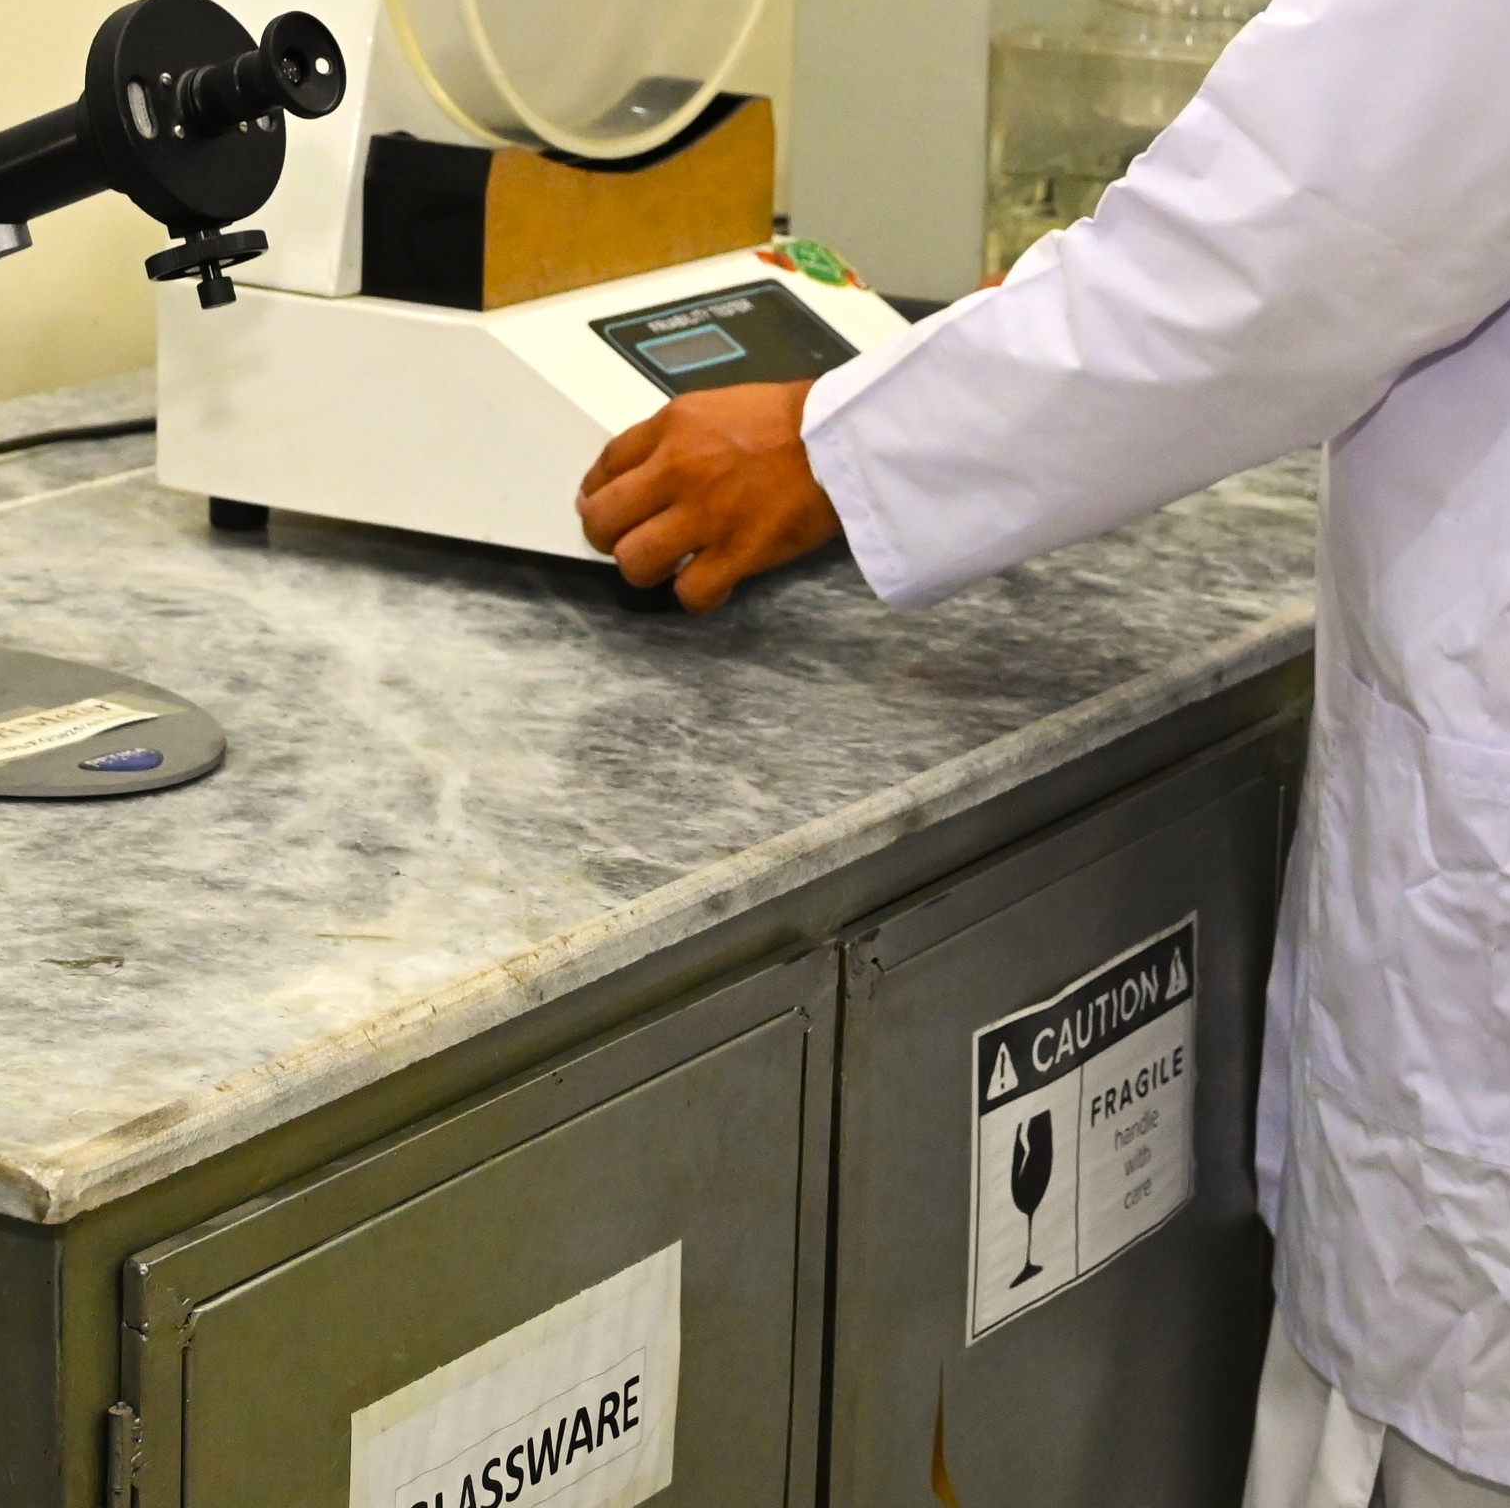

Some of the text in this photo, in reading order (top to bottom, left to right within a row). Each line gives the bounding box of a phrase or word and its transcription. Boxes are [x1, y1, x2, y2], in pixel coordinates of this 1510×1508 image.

[1031, 964, 1159, 1073] CAUTION
[1090, 1045, 1185, 1127] FRAGILE
[1113, 1105, 1160, 1152] handle
[1123, 1143, 1152, 1179] with
[1122, 1176, 1152, 1211] care
[409, 1374, 640, 1508] ASSWARE
